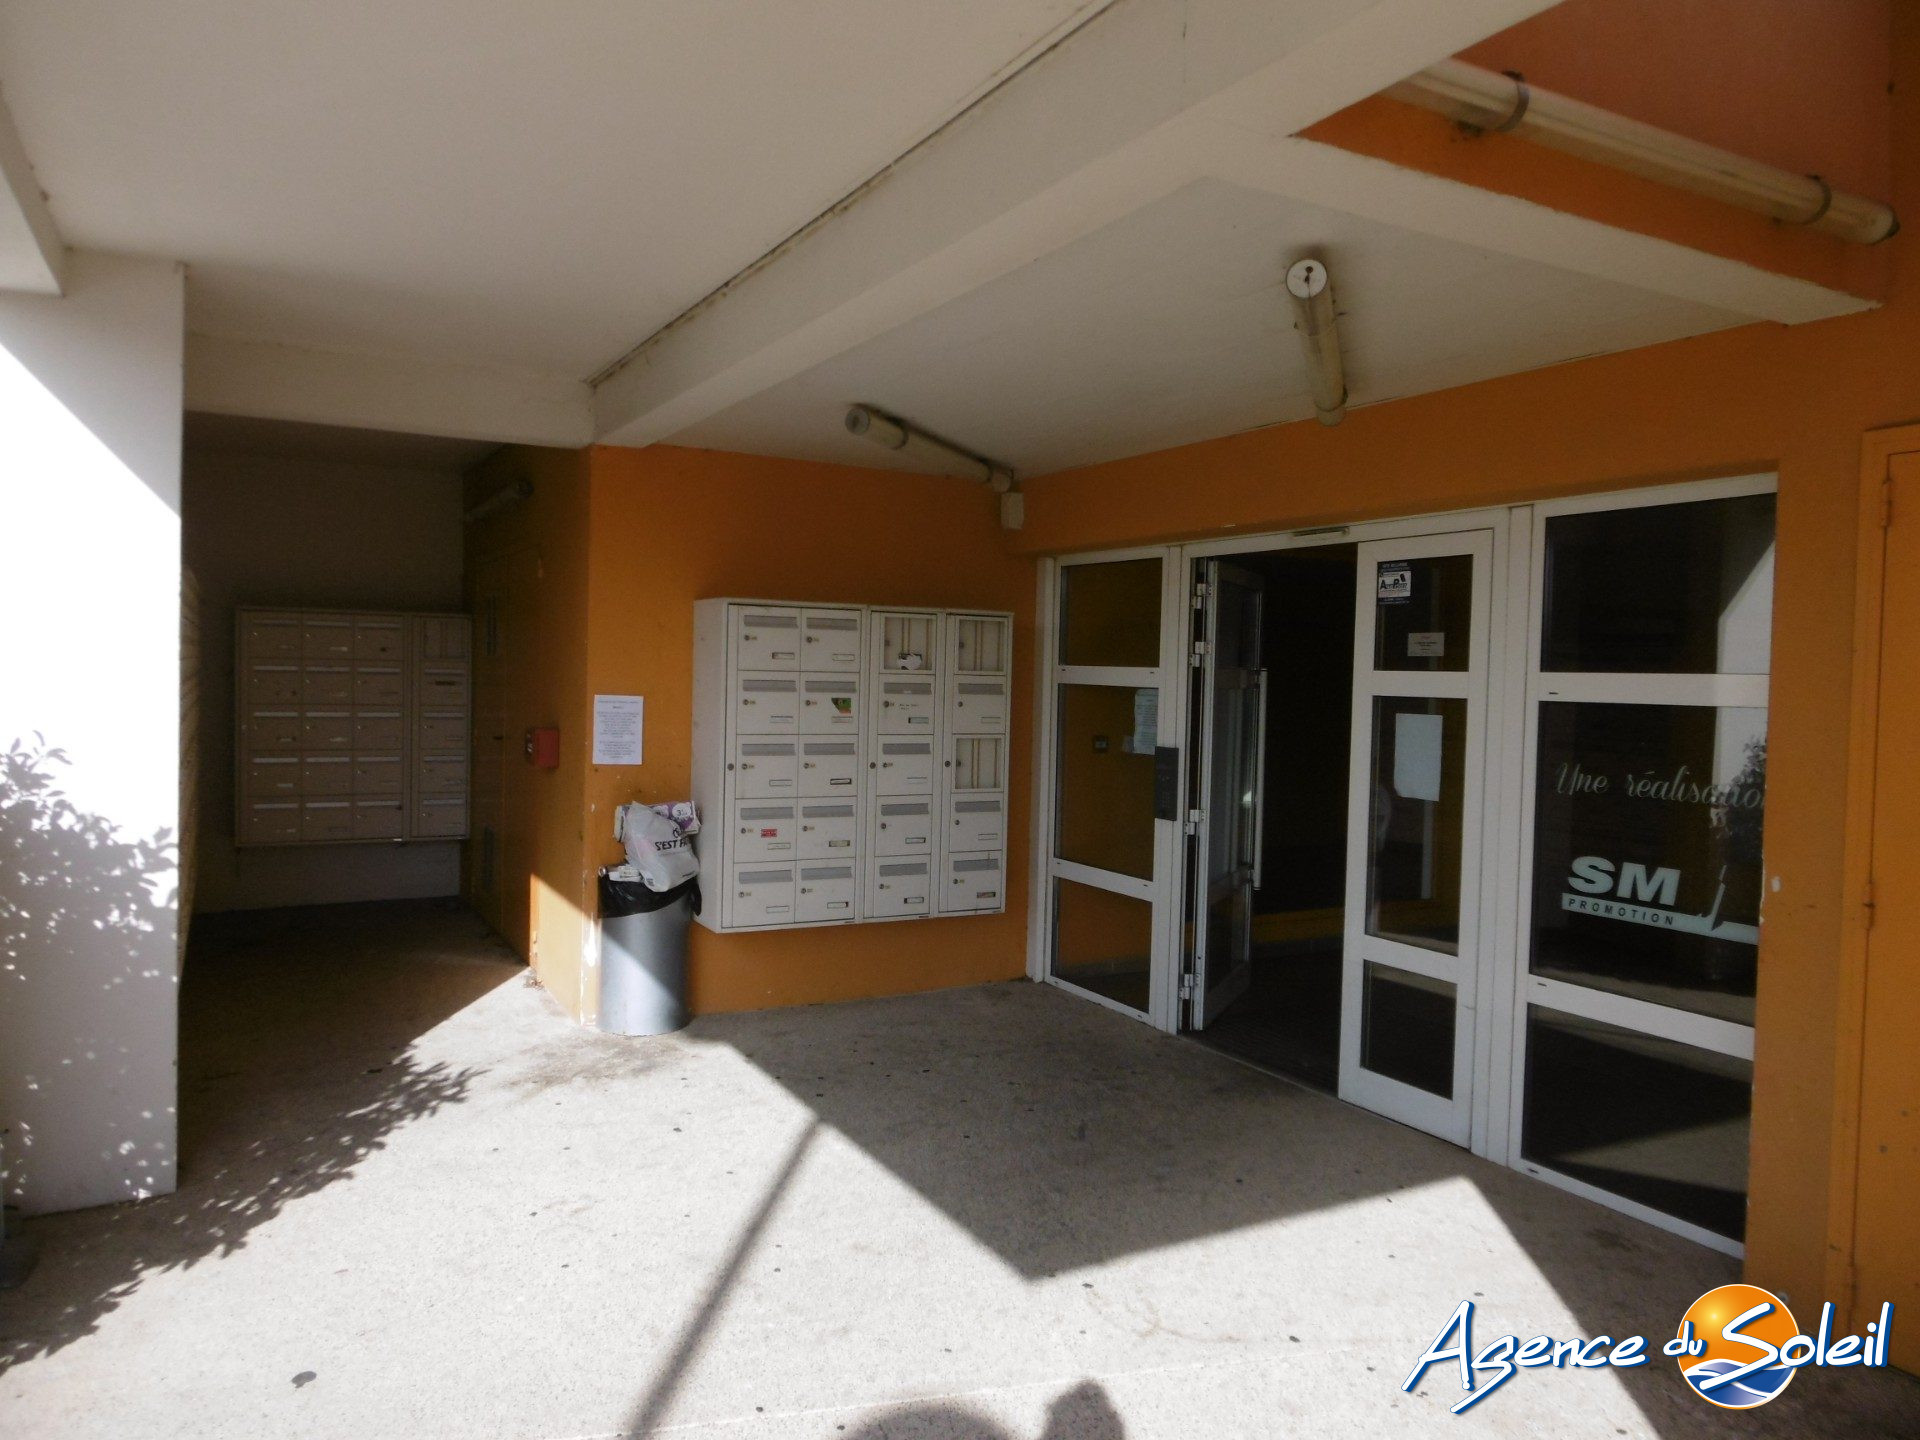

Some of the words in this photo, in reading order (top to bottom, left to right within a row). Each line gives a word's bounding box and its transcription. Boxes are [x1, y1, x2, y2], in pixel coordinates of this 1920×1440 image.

[1557, 763, 1609, 796] Une
[1567, 856, 1681, 906] SM
[1567, 898, 1674, 925] PROMOTION
